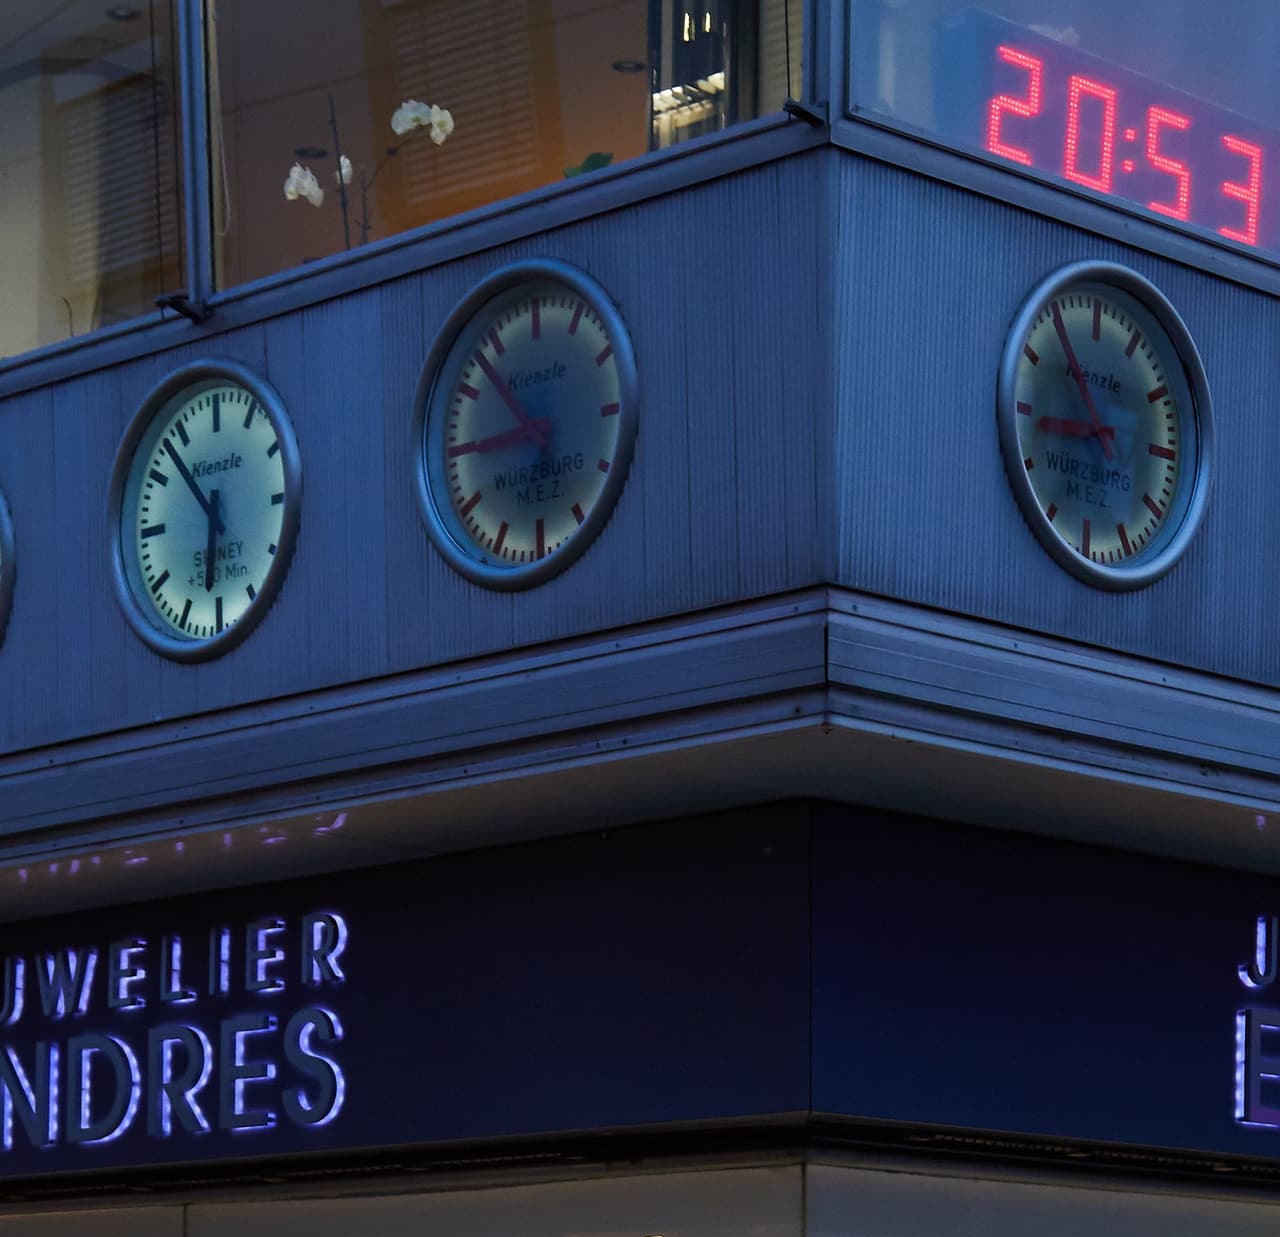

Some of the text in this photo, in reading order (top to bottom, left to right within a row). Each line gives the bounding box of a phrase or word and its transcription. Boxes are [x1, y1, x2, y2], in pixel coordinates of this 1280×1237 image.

[986, 44, 1264, 246] 20:53
[508, 361, 567, 391] Kienzle
[192, 452, 243, 478] Kienzle
[494, 452, 584, 491] WÜRZBURG
[1046, 450, 1131, 492] WÜRZBURG
[517, 479, 565, 506] M.E.Z.
[1066, 479, 1112, 509] M.E.Z.
